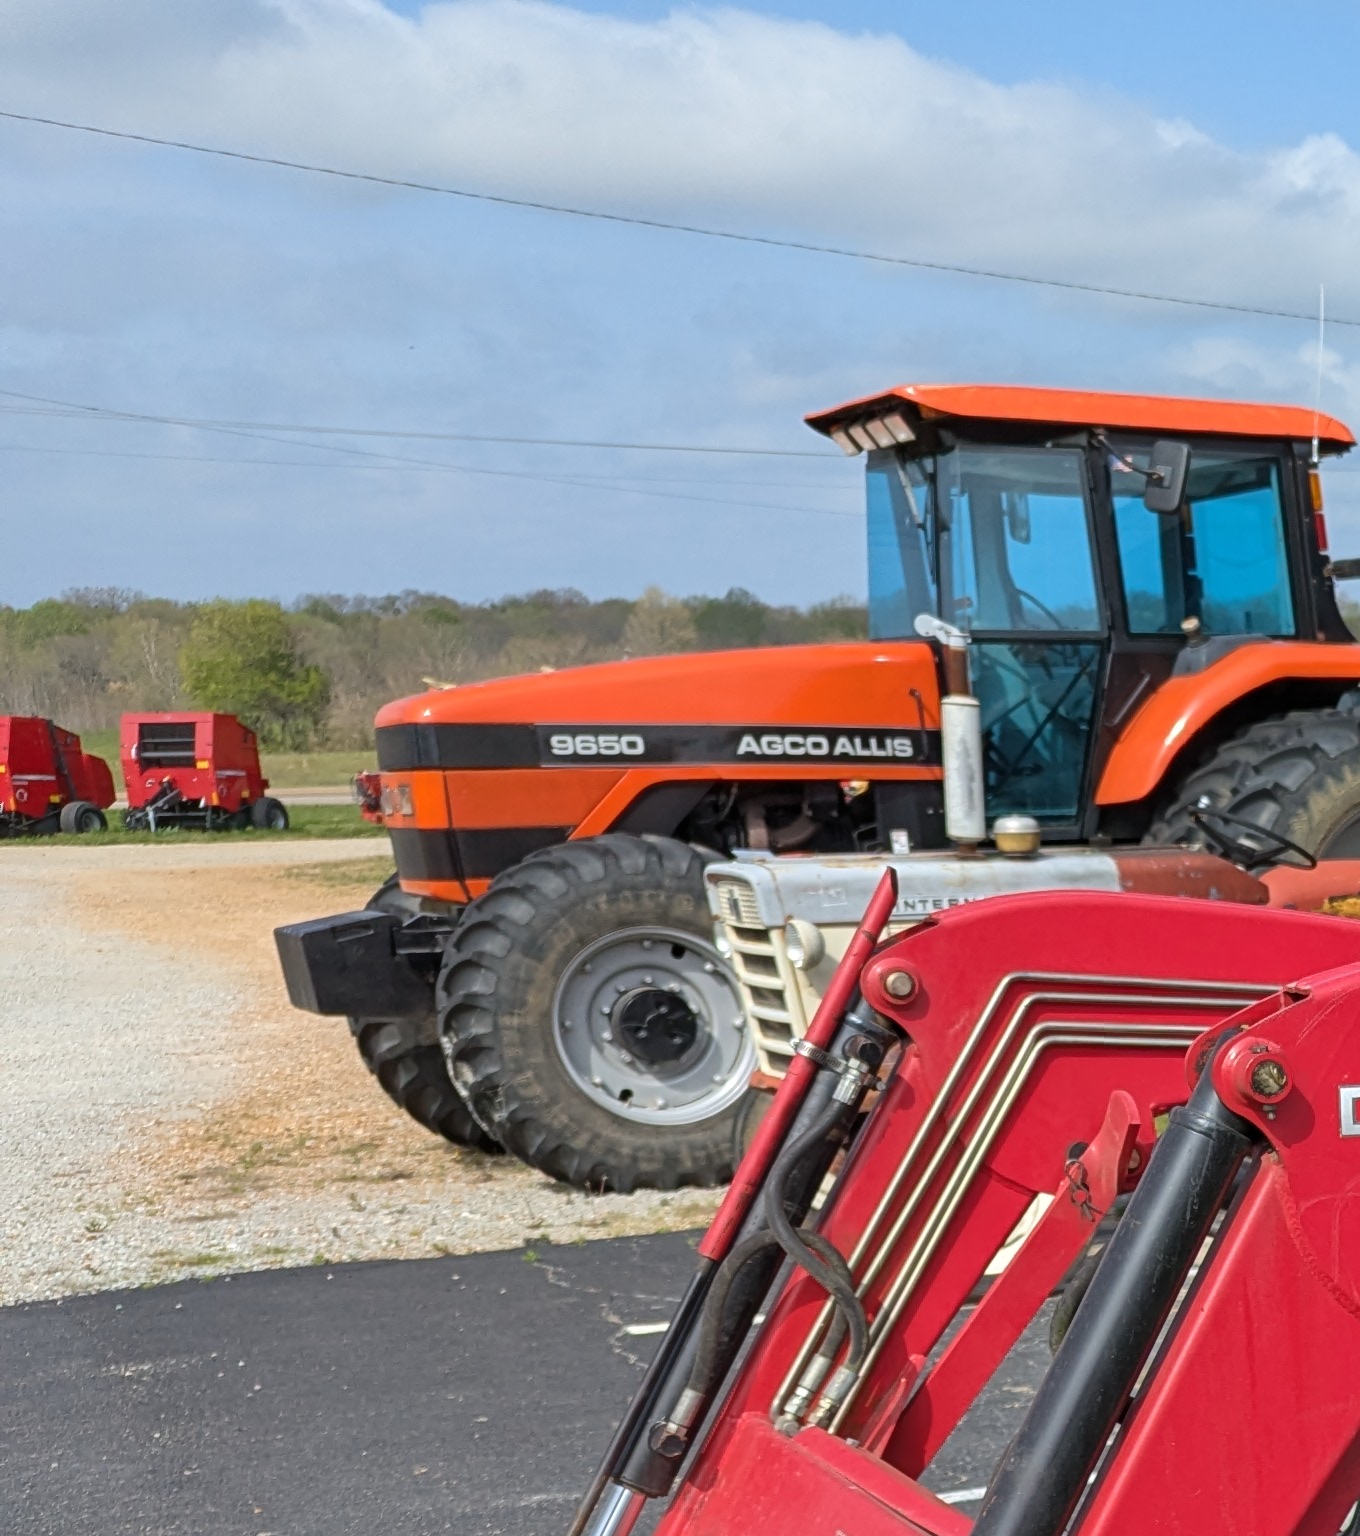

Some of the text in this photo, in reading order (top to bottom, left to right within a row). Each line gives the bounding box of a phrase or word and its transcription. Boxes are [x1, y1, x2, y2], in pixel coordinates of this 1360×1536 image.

[550, 734, 645, 756] 9650
[736, 733, 914, 758] AGCO ALLIS
